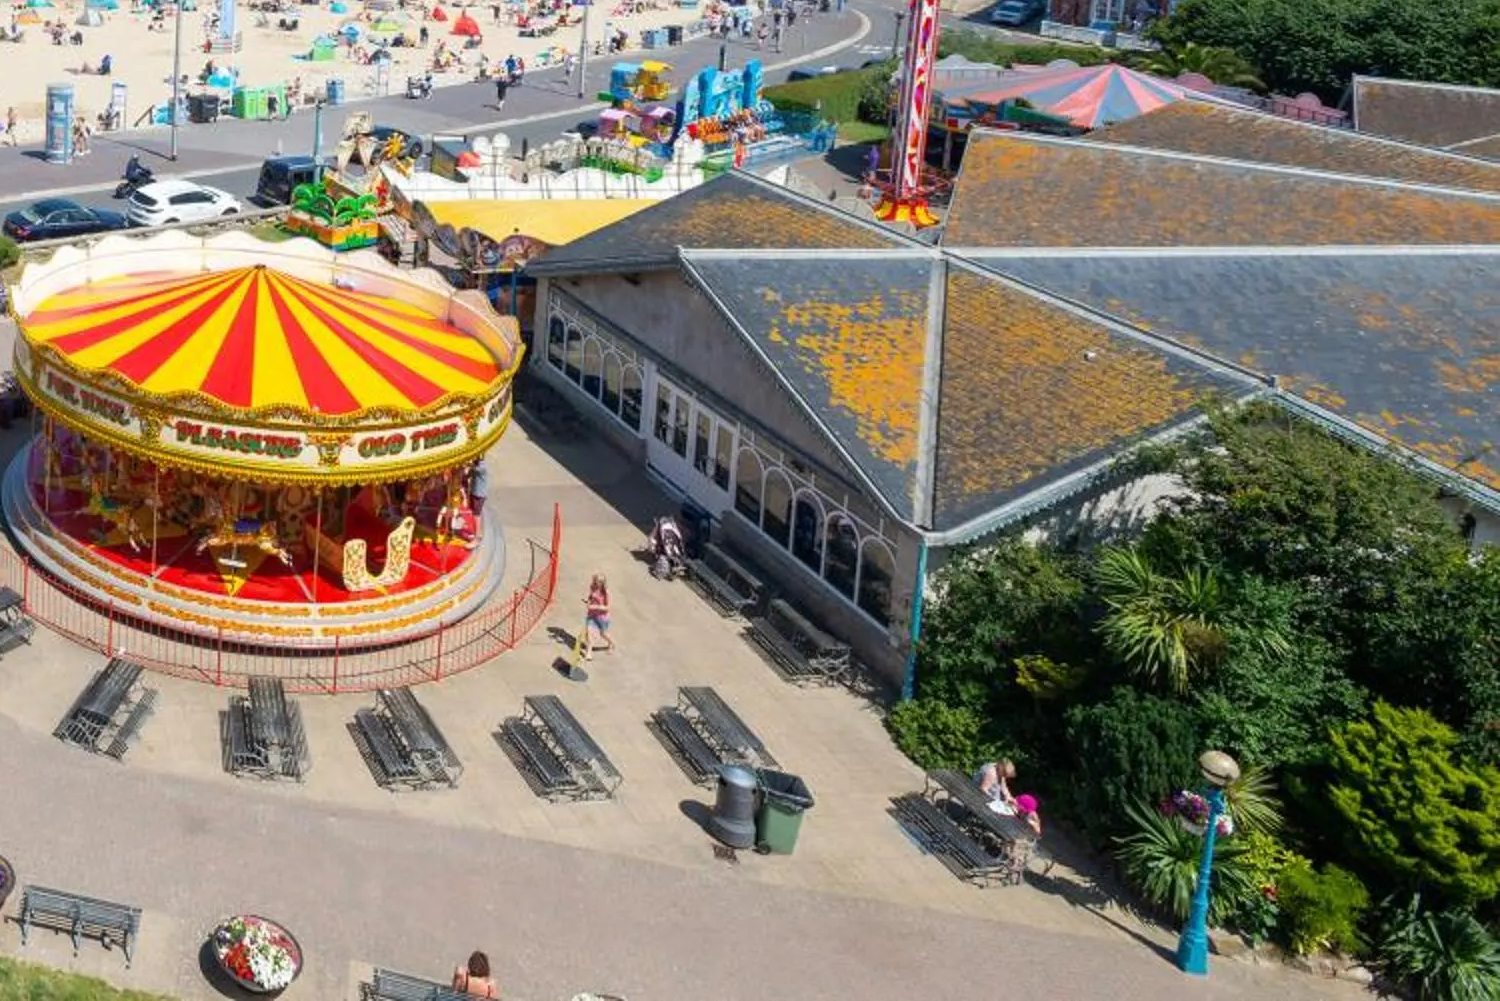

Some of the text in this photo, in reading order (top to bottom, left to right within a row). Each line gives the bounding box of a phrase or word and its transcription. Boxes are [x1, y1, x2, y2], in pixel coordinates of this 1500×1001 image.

[176, 420, 303, 459] PLEASURE
[358, 422, 460, 459] OLD TIME
